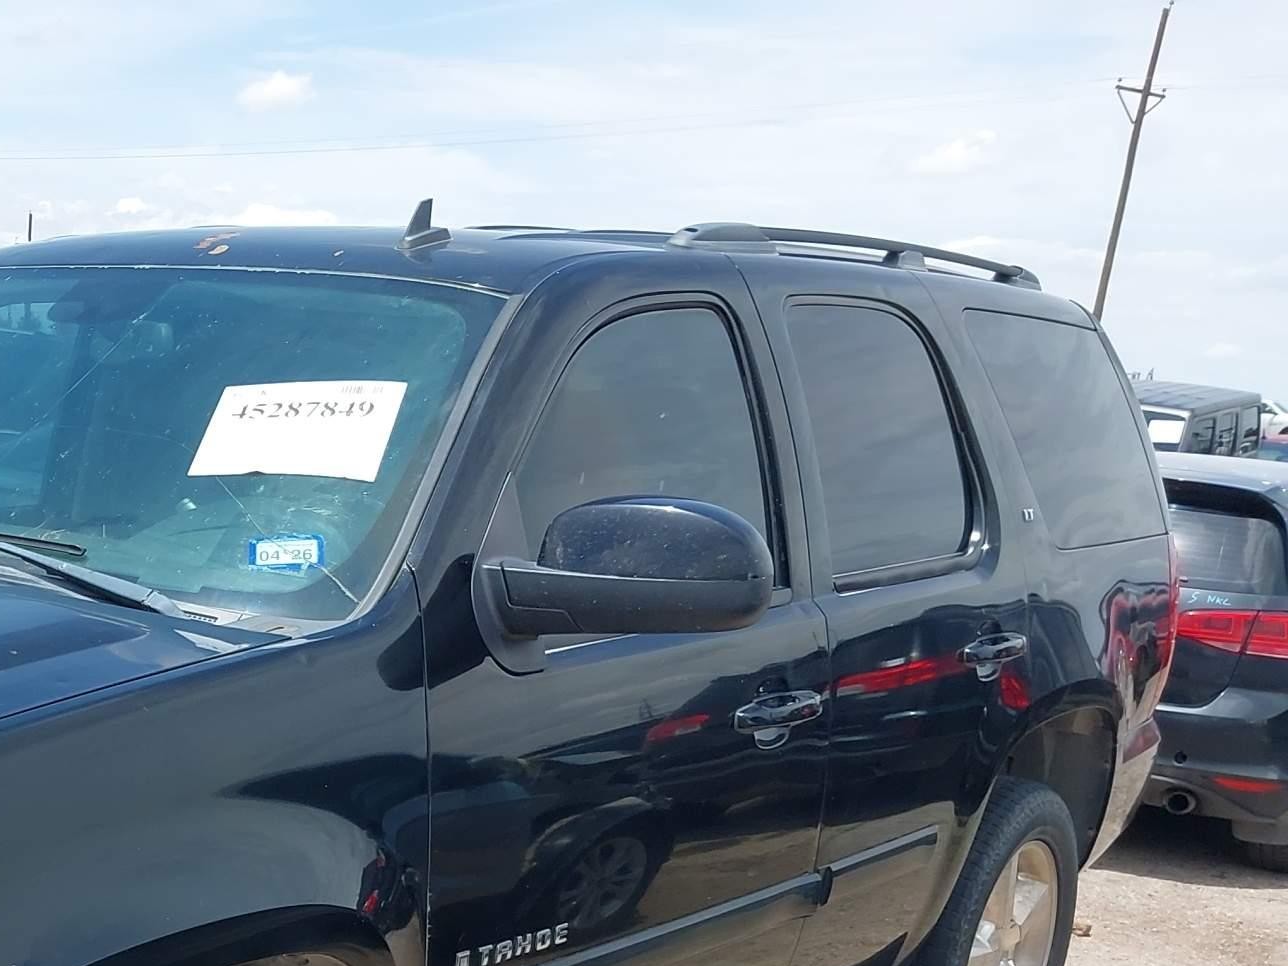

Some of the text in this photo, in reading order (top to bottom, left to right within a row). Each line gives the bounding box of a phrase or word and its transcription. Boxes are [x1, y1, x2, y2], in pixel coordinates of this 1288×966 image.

[231, 401, 375, 419] 45287849
[1023, 508, 1034, 521] LT
[259, 549, 313, 562] 04 26
